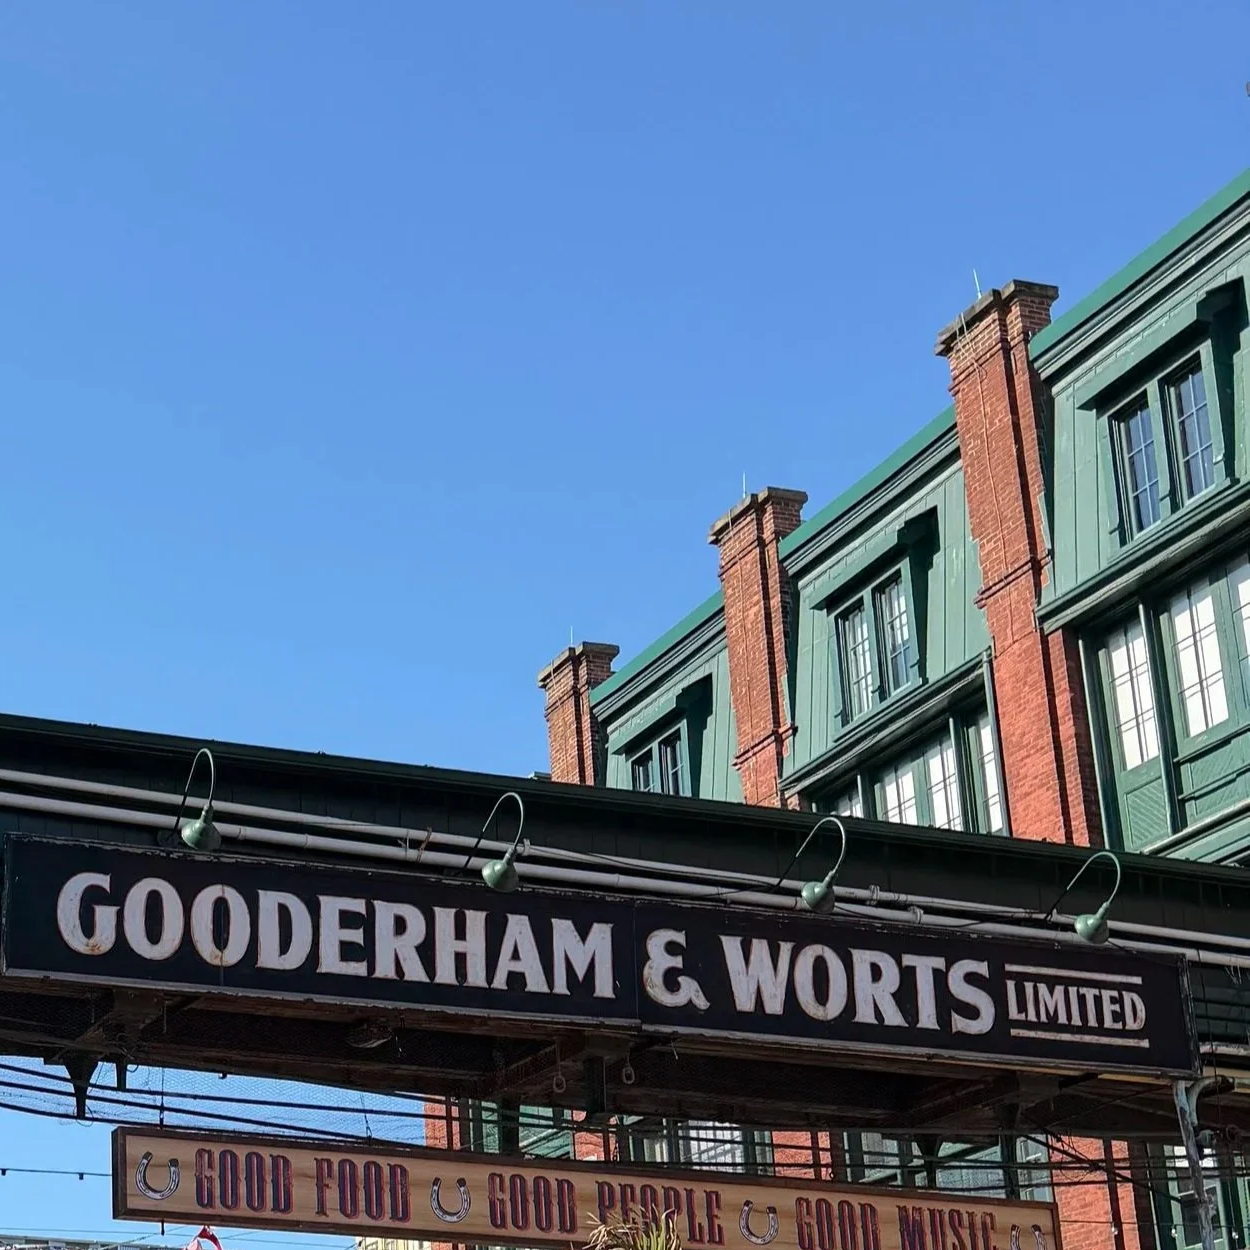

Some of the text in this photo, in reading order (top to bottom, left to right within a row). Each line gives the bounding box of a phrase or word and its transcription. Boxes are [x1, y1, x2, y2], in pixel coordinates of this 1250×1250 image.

[57, 872, 1147, 1036] GOODERHAM & WORTS LIMITED
[194, 1147, 295, 1215] GOOD
[313, 1156, 412, 1223] FOOD
[487, 1171, 579, 1236] GOOD
